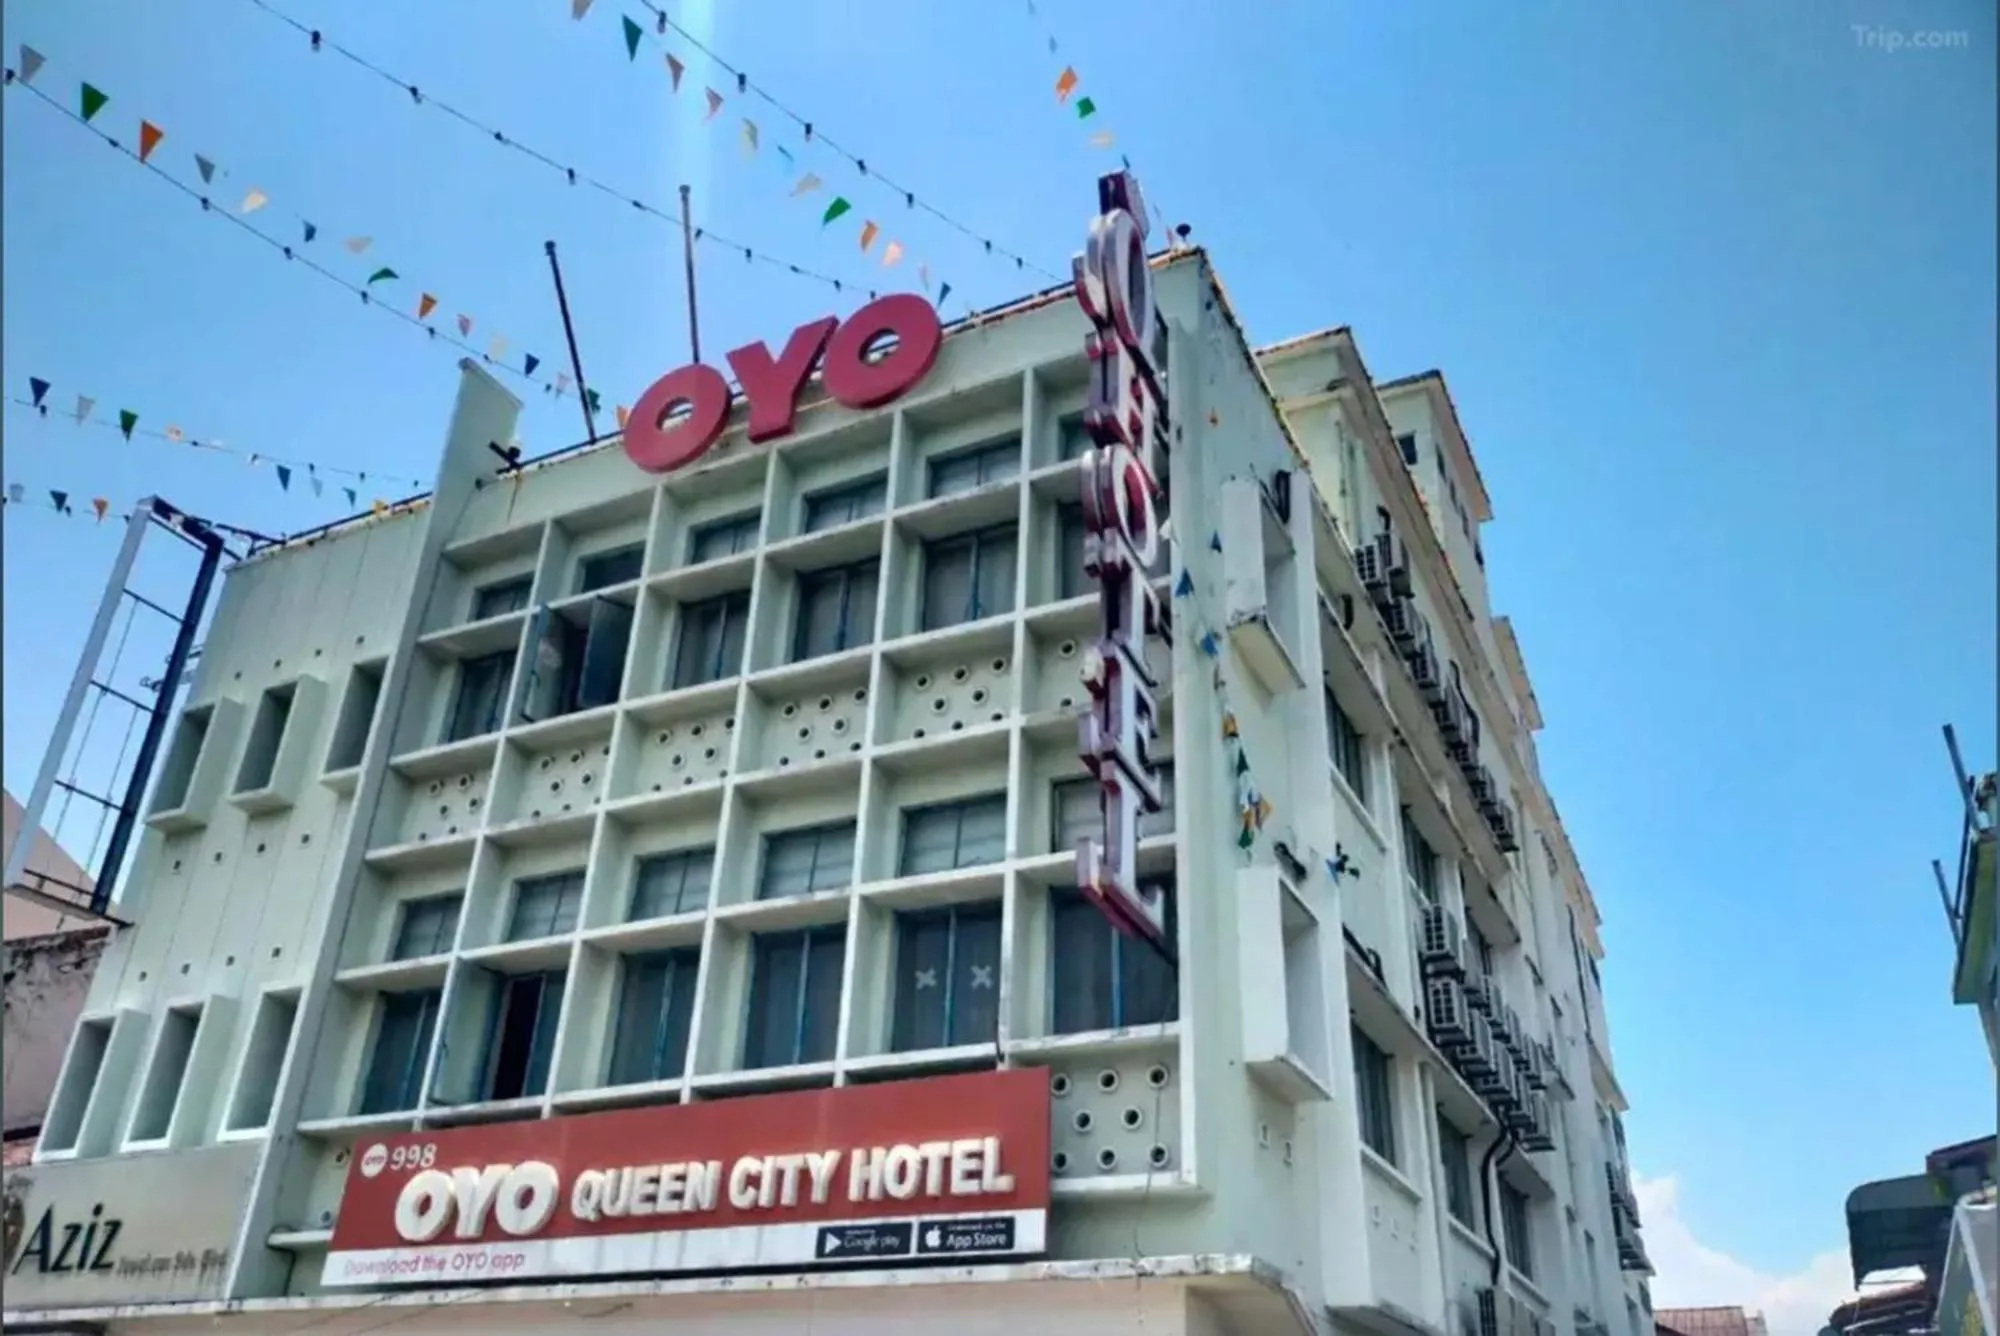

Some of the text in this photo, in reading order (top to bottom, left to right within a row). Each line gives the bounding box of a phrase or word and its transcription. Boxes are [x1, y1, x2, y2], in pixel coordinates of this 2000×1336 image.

[623, 293, 942, 473] OYO
[390, 1143, 438, 1171] 998
[395, 1136, 1016, 1241] OYO QUEEN CITY HOTEL
[12, 1202, 122, 1275] Aziz
[946, 1231, 1008, 1249] App Store
[344, 1256, 420, 1276] Download
[452, 1252, 489, 1271] OYO
[491, 1253, 526, 1272] app
